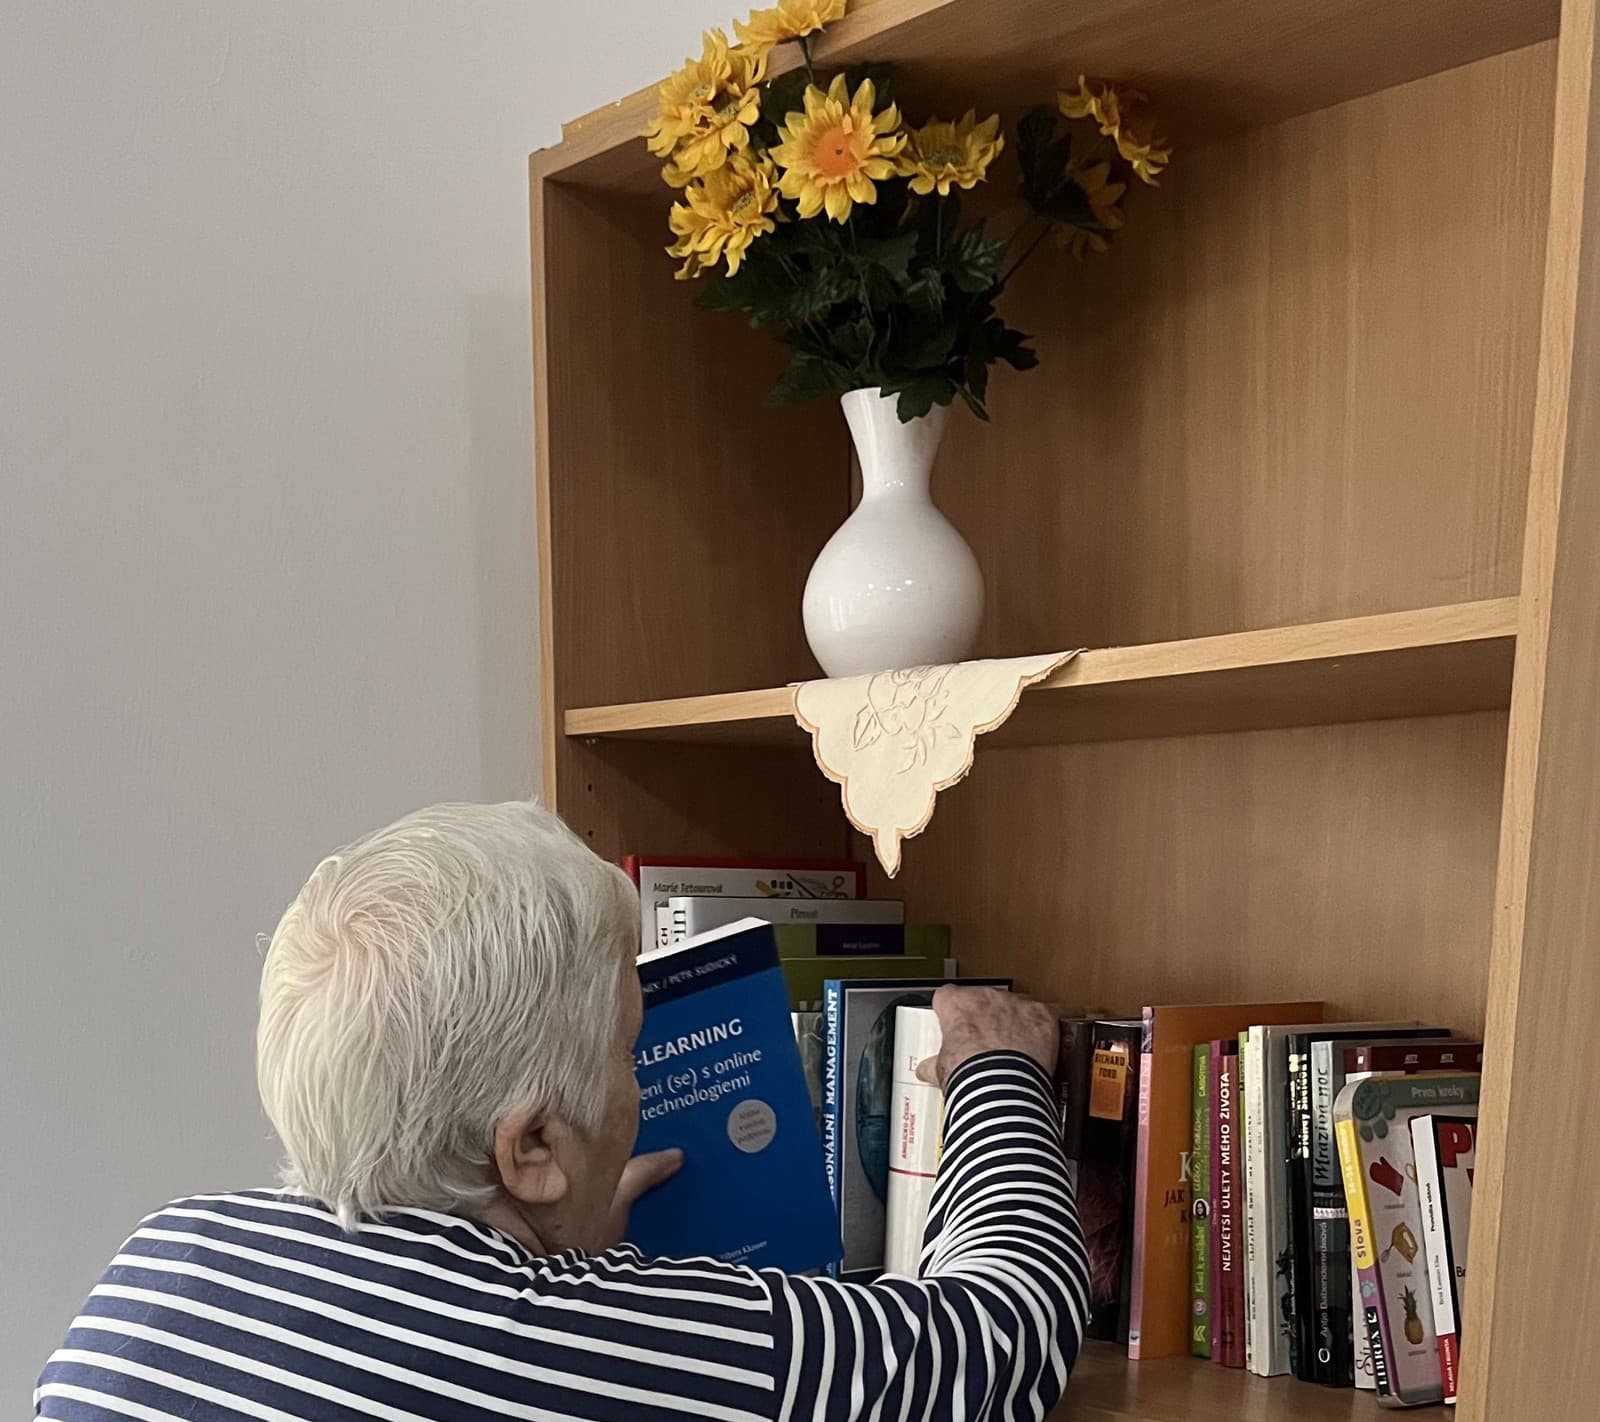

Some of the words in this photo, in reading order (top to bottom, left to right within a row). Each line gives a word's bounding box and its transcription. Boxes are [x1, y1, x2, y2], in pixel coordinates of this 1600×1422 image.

[825, 988, 838, 1105] MANAGEMENT
[1095, 1052, 1125, 1067] RICHARD
[667, 1067, 698, 1094] (se)
[701, 1066, 711, 1079] s
[713, 1049, 763, 1075] online
[1099, 1067, 1117, 1079] FORD
[1317, 1067, 1329, 1096] noc
[641, 1071, 751, 1121] technologiemi
[1411, 1086, 1436, 1098] První
[1353, 1218, 1367, 1258] Slova
[1369, 1328, 1388, 1386] LIBREX
